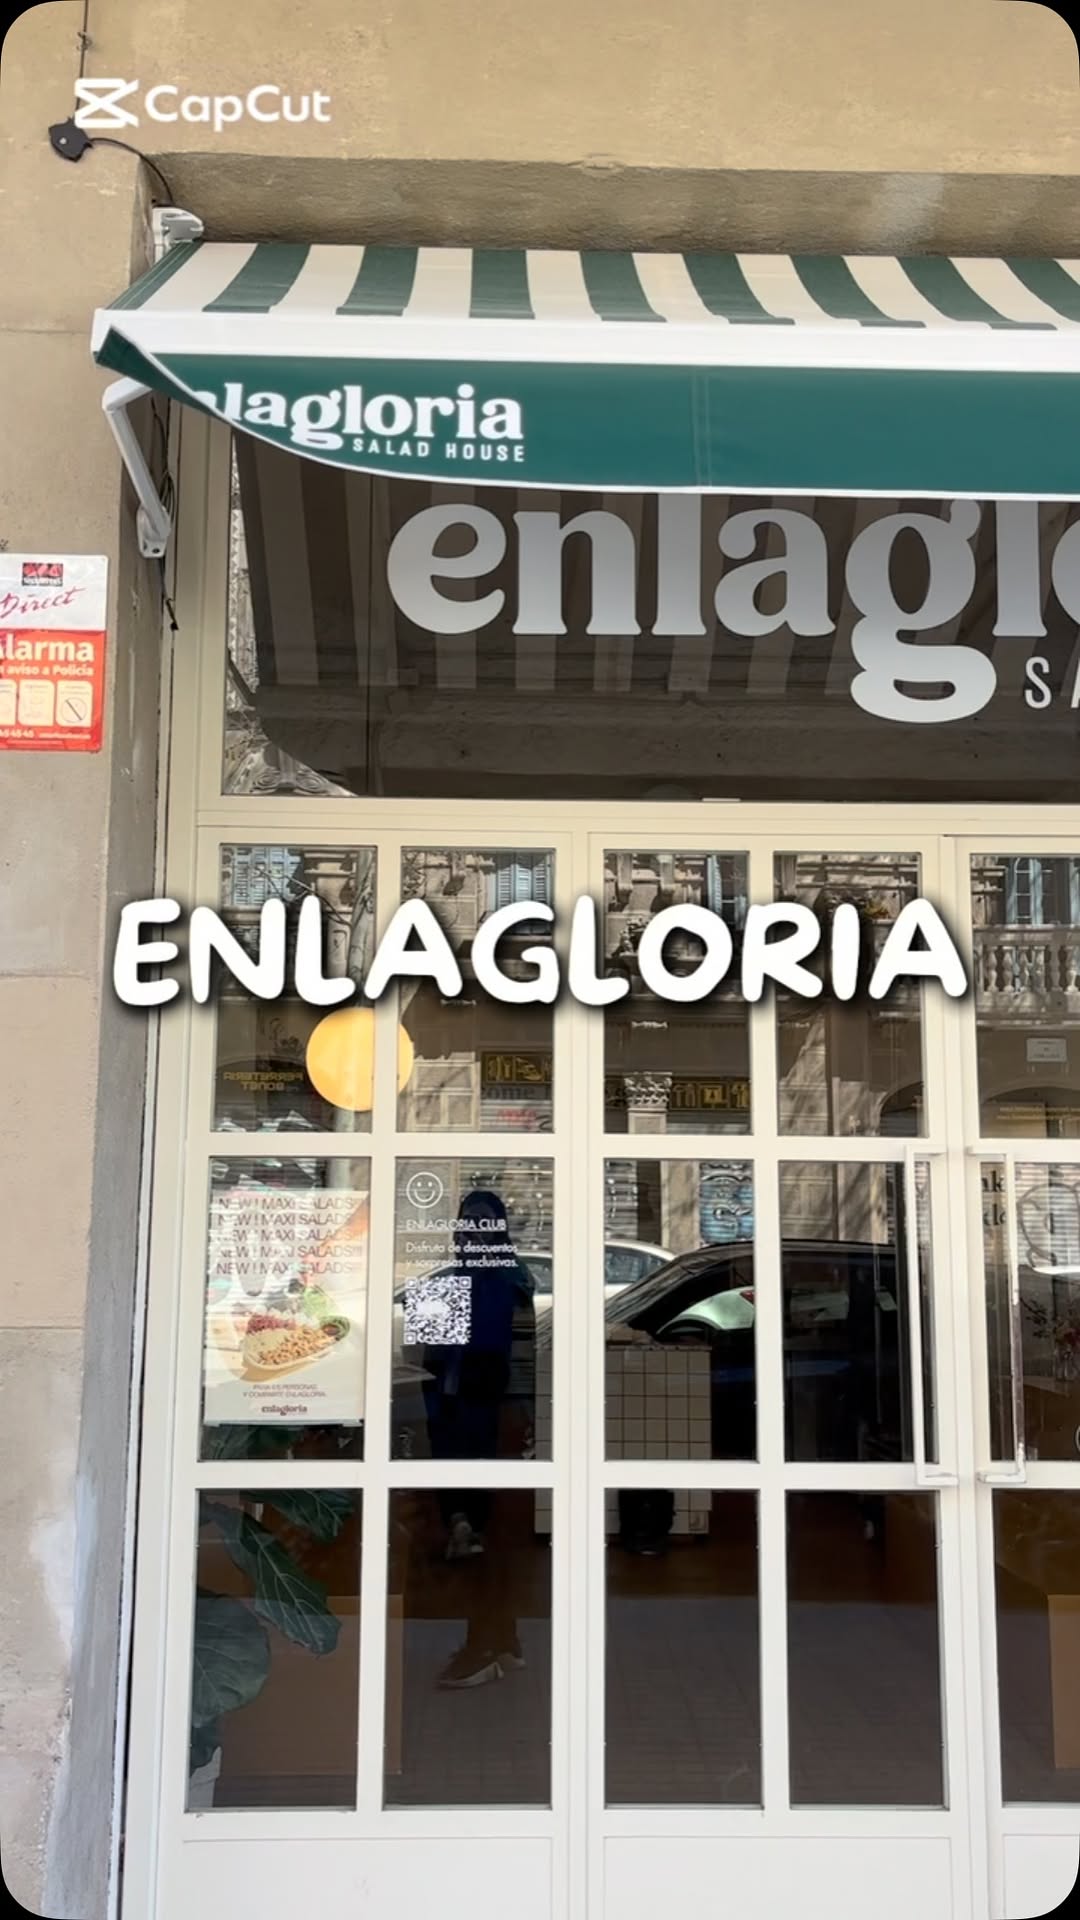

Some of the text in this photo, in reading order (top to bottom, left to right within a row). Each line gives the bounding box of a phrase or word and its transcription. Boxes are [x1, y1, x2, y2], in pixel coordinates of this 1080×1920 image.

[353, 438, 525, 462] SALAD HOUSE
[387, 493, 1080, 723] enlagl
[0, 633, 94, 662] larma
[7, 663, 39, 676] aviso
[406, 1219, 507, 1231] ENLAGLORIA CLUB
[406, 1240, 518, 1254] Disfruta de descuentos
